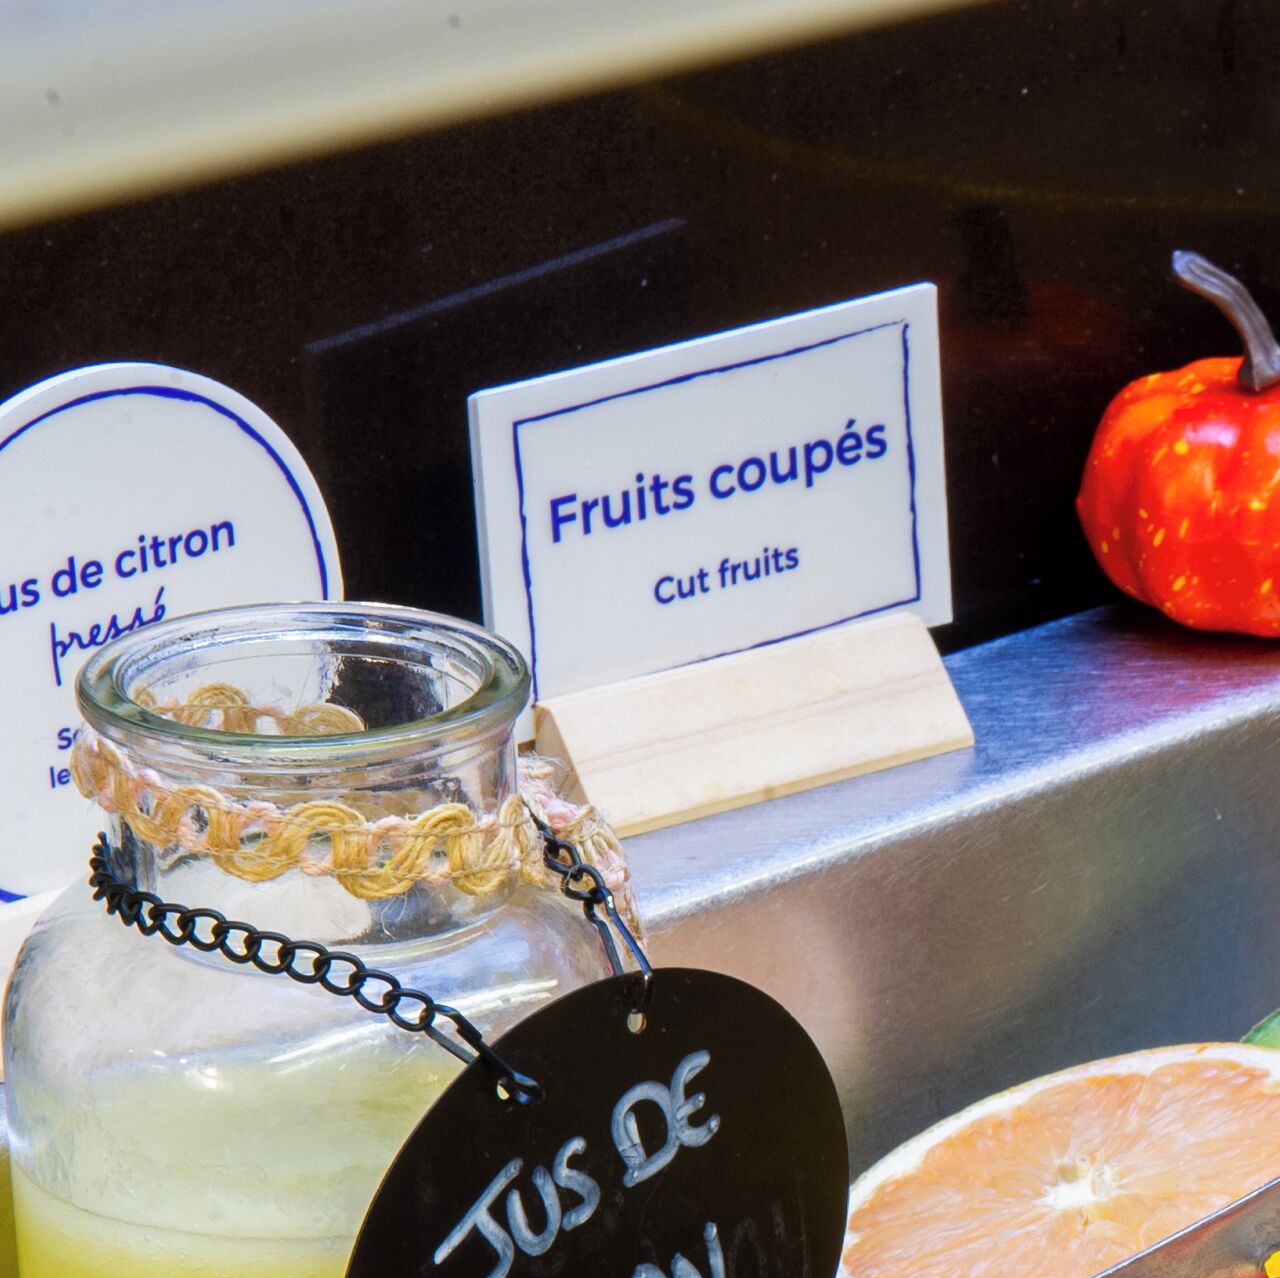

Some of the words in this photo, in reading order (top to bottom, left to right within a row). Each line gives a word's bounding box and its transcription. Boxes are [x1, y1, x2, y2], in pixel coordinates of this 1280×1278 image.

[549, 472, 695, 544] Fruits
[708, 418, 888, 500] coupés
[0, 578, 40, 616] us
[51, 556, 104, 598] de
[114, 520, 235, 579] citron
[654, 567, 710, 605] Cut
[717, 547, 800, 589] fruits
[50, 585, 166, 687] pressé
[610, 1049, 721, 1189] DE
